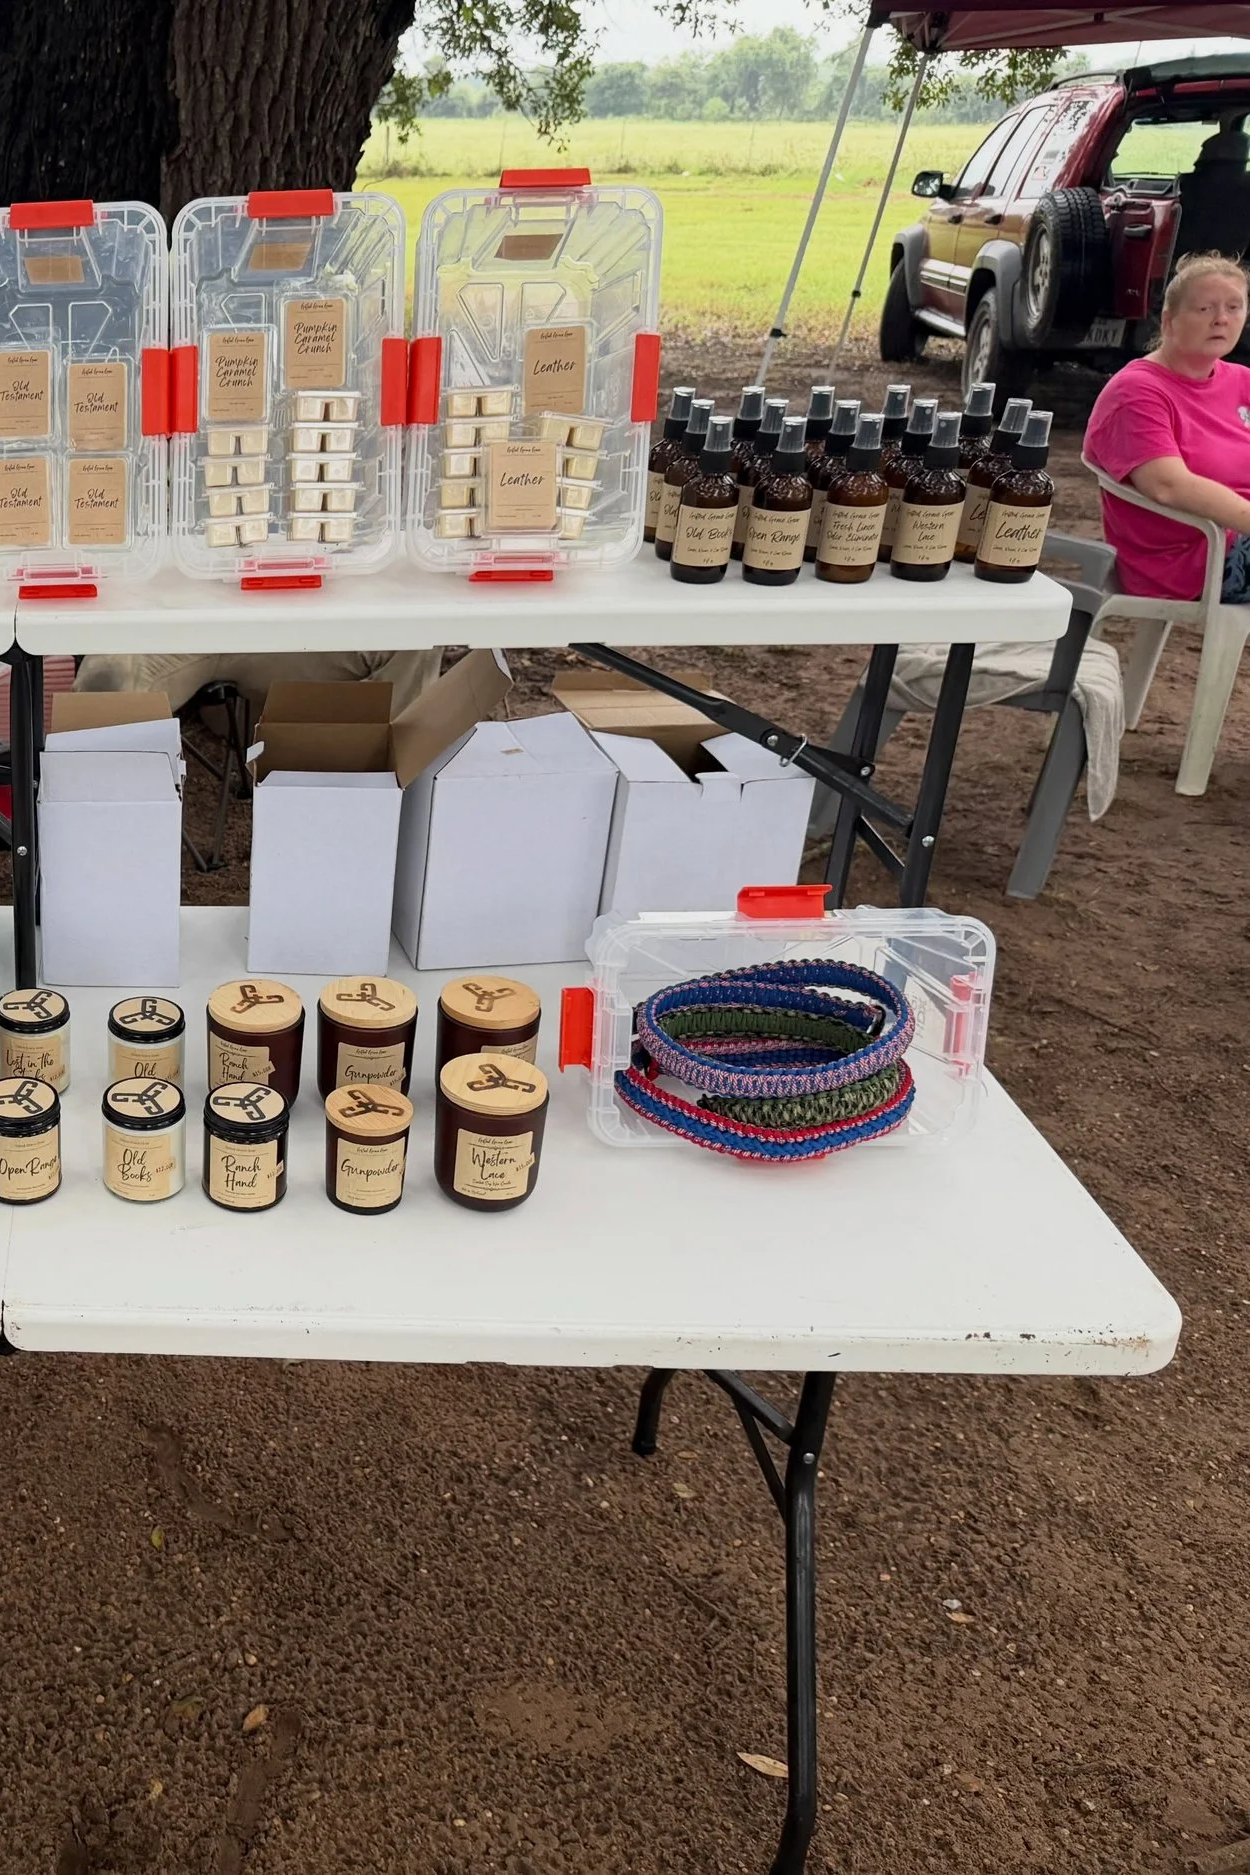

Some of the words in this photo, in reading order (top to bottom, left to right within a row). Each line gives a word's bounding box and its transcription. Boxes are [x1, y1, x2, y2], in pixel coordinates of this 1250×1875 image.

[294, 322, 337, 334] Pumpkin
[295, 332, 335, 345] Caramel
[297, 343, 332, 354] Crunch
[215, 355, 258, 368] Pumpkin
[533, 359, 577, 376] Leather
[216, 366, 256, 378] Caramel
[11, 381, 30, 392] Old
[219, 376, 253, 388] Crunch
[0, 390, 44, 402] Testament
[86, 392, 104, 404] Old
[74, 401, 119, 413] Testament
[500, 472, 545, 487] Leather
[10, 488, 29, 499] Old
[87, 488, 105, 500] Old
[74, 498, 119, 510] Testament
[833, 521, 854, 531] Fresh
[856, 521, 876, 532] Linen
[913, 521, 945, 531] Western
[995, 522, 1043, 540] Leather
[686, 528, 703, 540] Old
[708, 527, 733, 540] Books
[748, 526, 767, 542] Open
[771, 530, 802, 544] Range
[918, 532, 935, 541] Lace
[6, 1049, 24, 1070] Lost
[219, 1052, 249, 1070] Ranch
[134, 1062, 156, 1077] Old
[222, 1066, 246, 1082] Hand
[344, 1063, 397, 1083] Gunpowder
[122, 1148, 147, 1166] Old
[221, 1154, 261, 1172] Ranch
[471, 1147, 516, 1169] Western
[28, 1155, 58, 1177] Range
[118, 1163, 152, 1183] Books
[341, 1157, 400, 1182] Gunpowder
[480, 1165, 505, 1181] Lace
[225, 1171, 258, 1191] Hand
